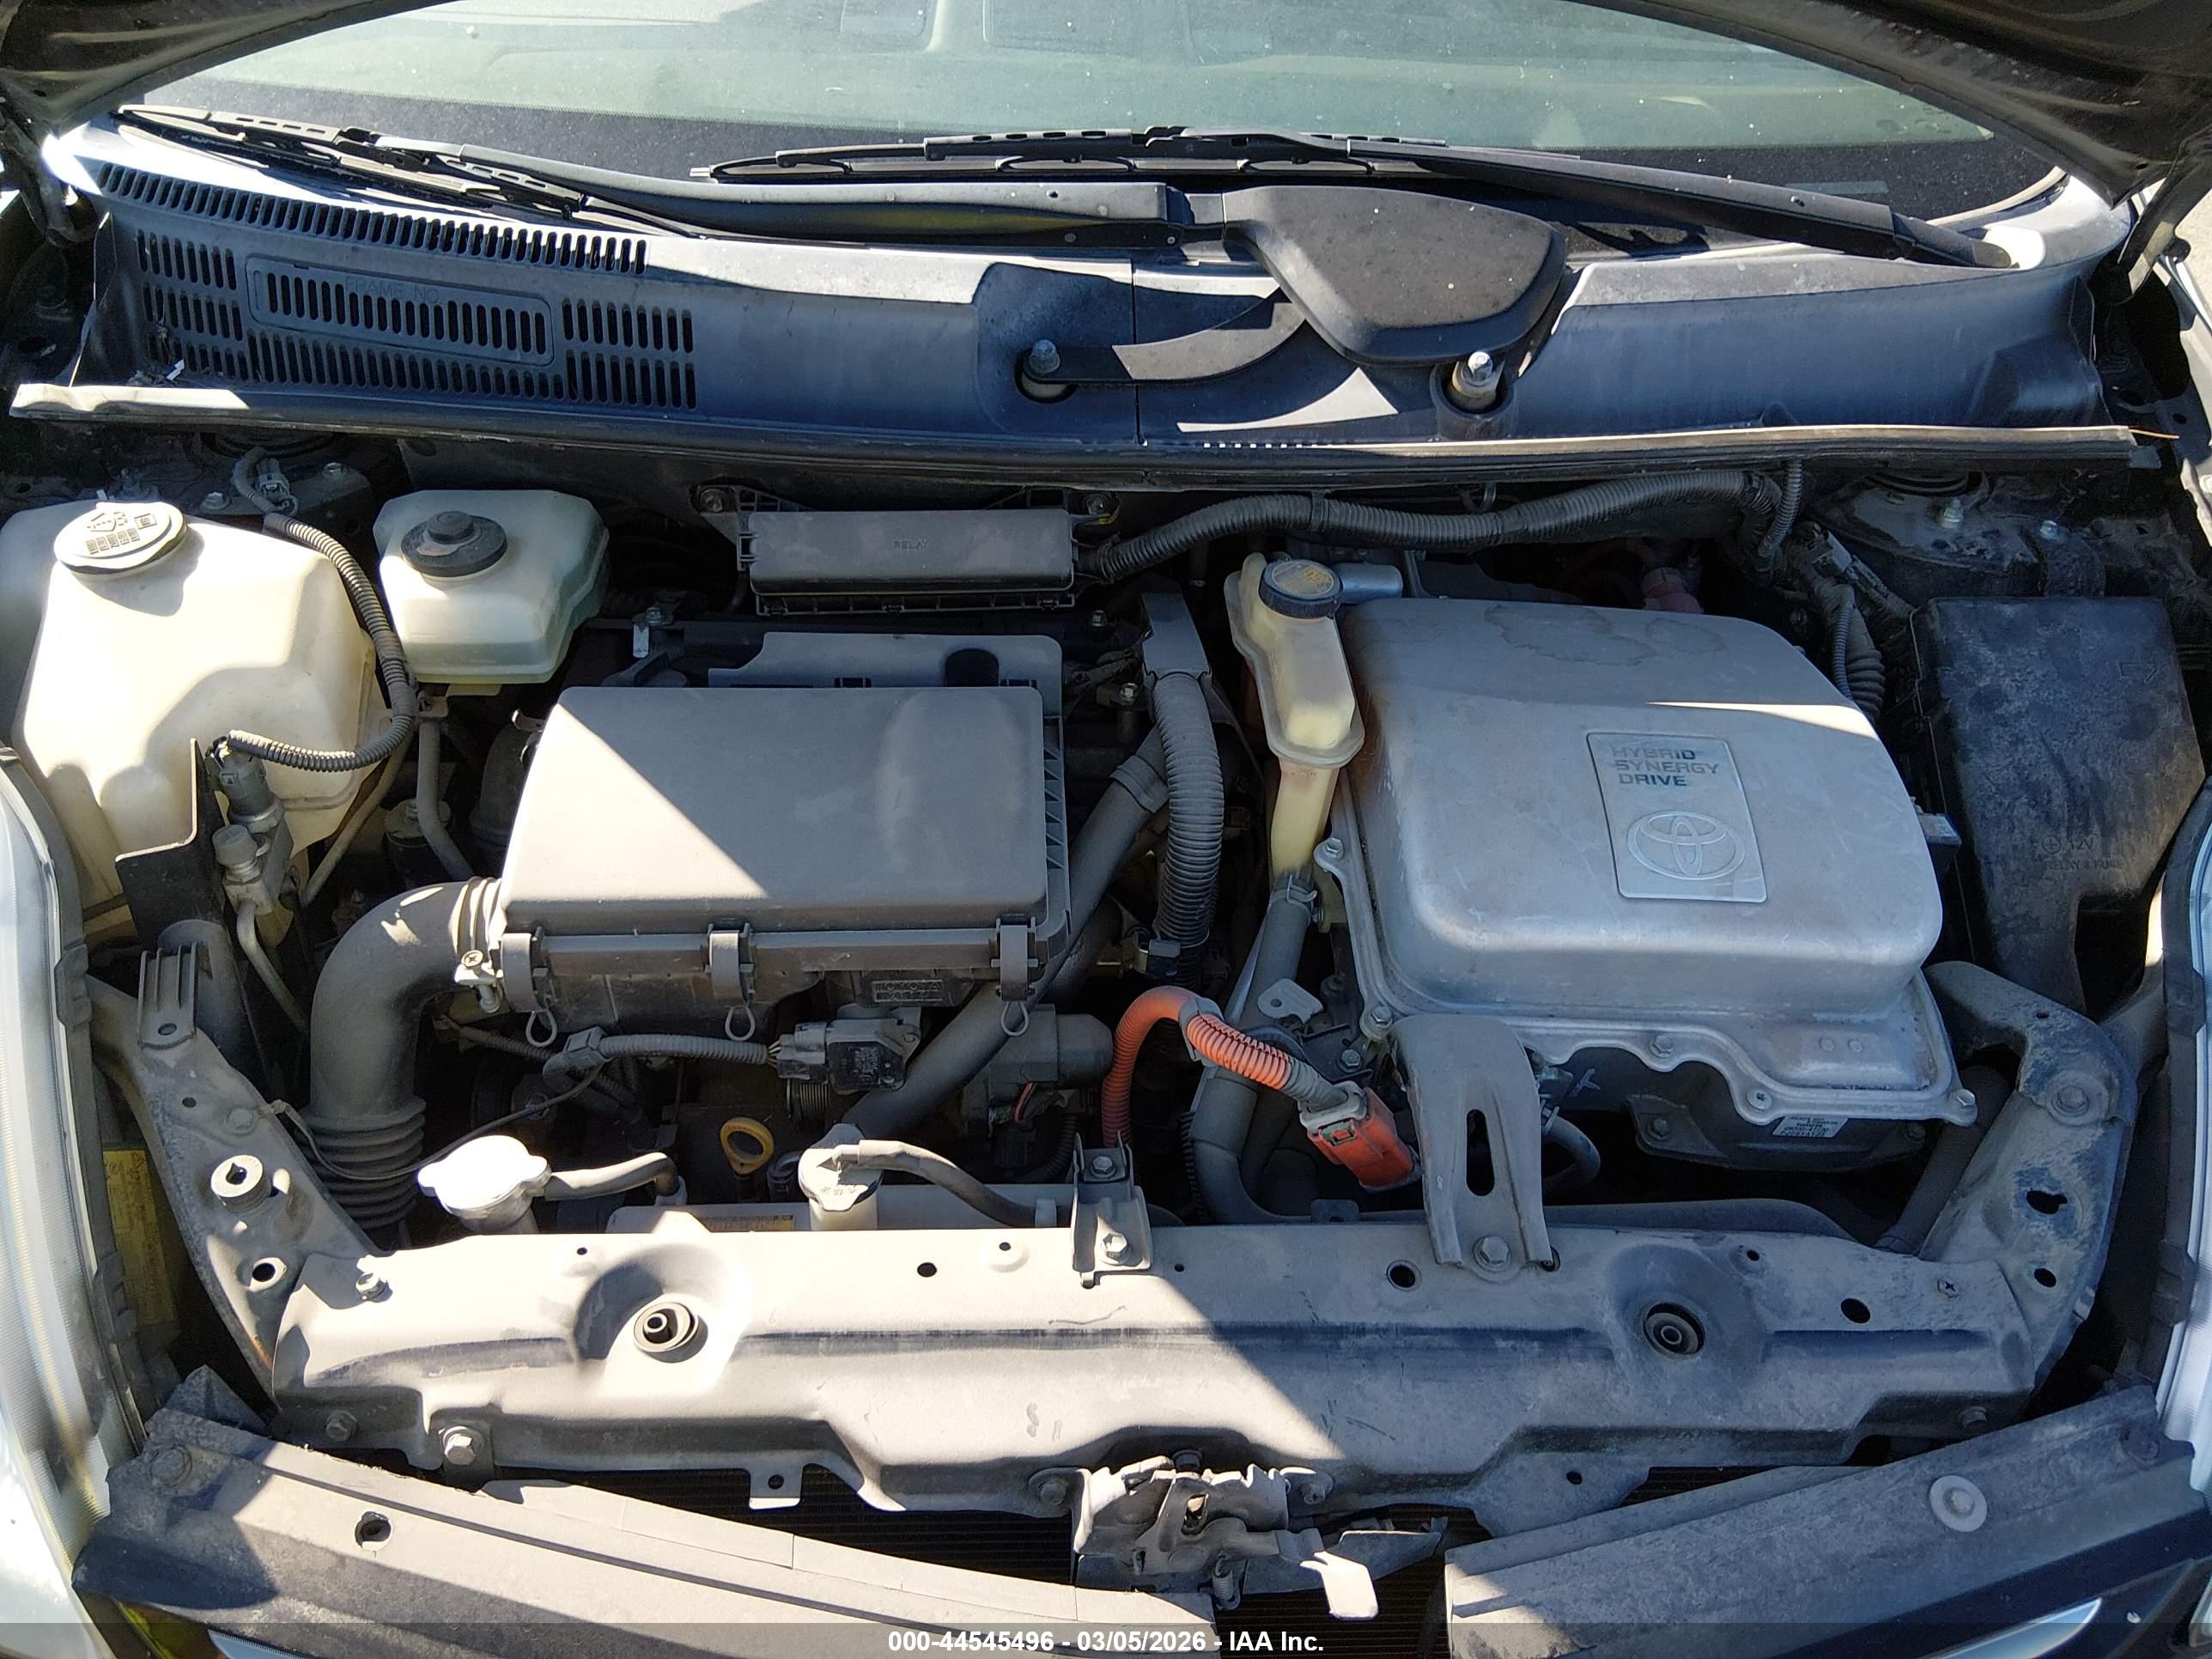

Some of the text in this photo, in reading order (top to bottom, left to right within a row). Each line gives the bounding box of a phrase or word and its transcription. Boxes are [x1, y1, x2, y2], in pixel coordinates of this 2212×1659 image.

[893, 540, 928, 550] RELAY
[1611, 744, 1697, 761] HYBRID
[1614, 760, 1719, 775] SYNERGY
[1619, 774, 1688, 787] DRIVE
